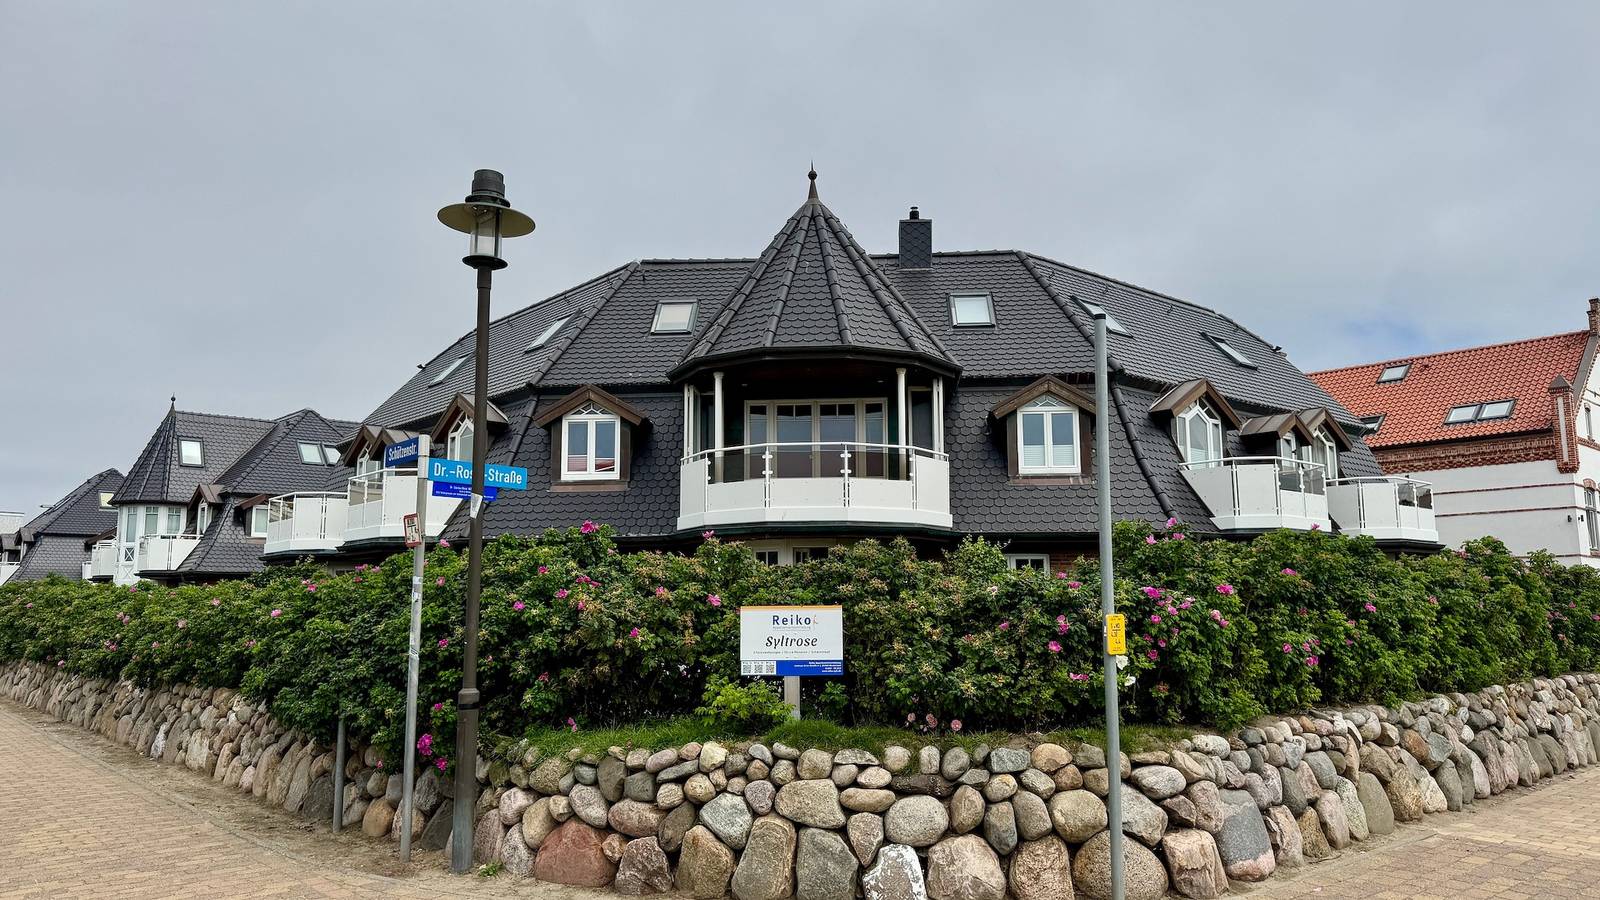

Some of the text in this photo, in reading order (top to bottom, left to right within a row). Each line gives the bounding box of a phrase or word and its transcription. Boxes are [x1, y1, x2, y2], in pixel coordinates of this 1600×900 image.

[388, 442, 417, 461] Schützenstr.
[433, 462, 522, 484] Dr.-Ros-Straße
[772, 614, 811, 626] Reiko
[765, 635, 818, 649] Syltrose
